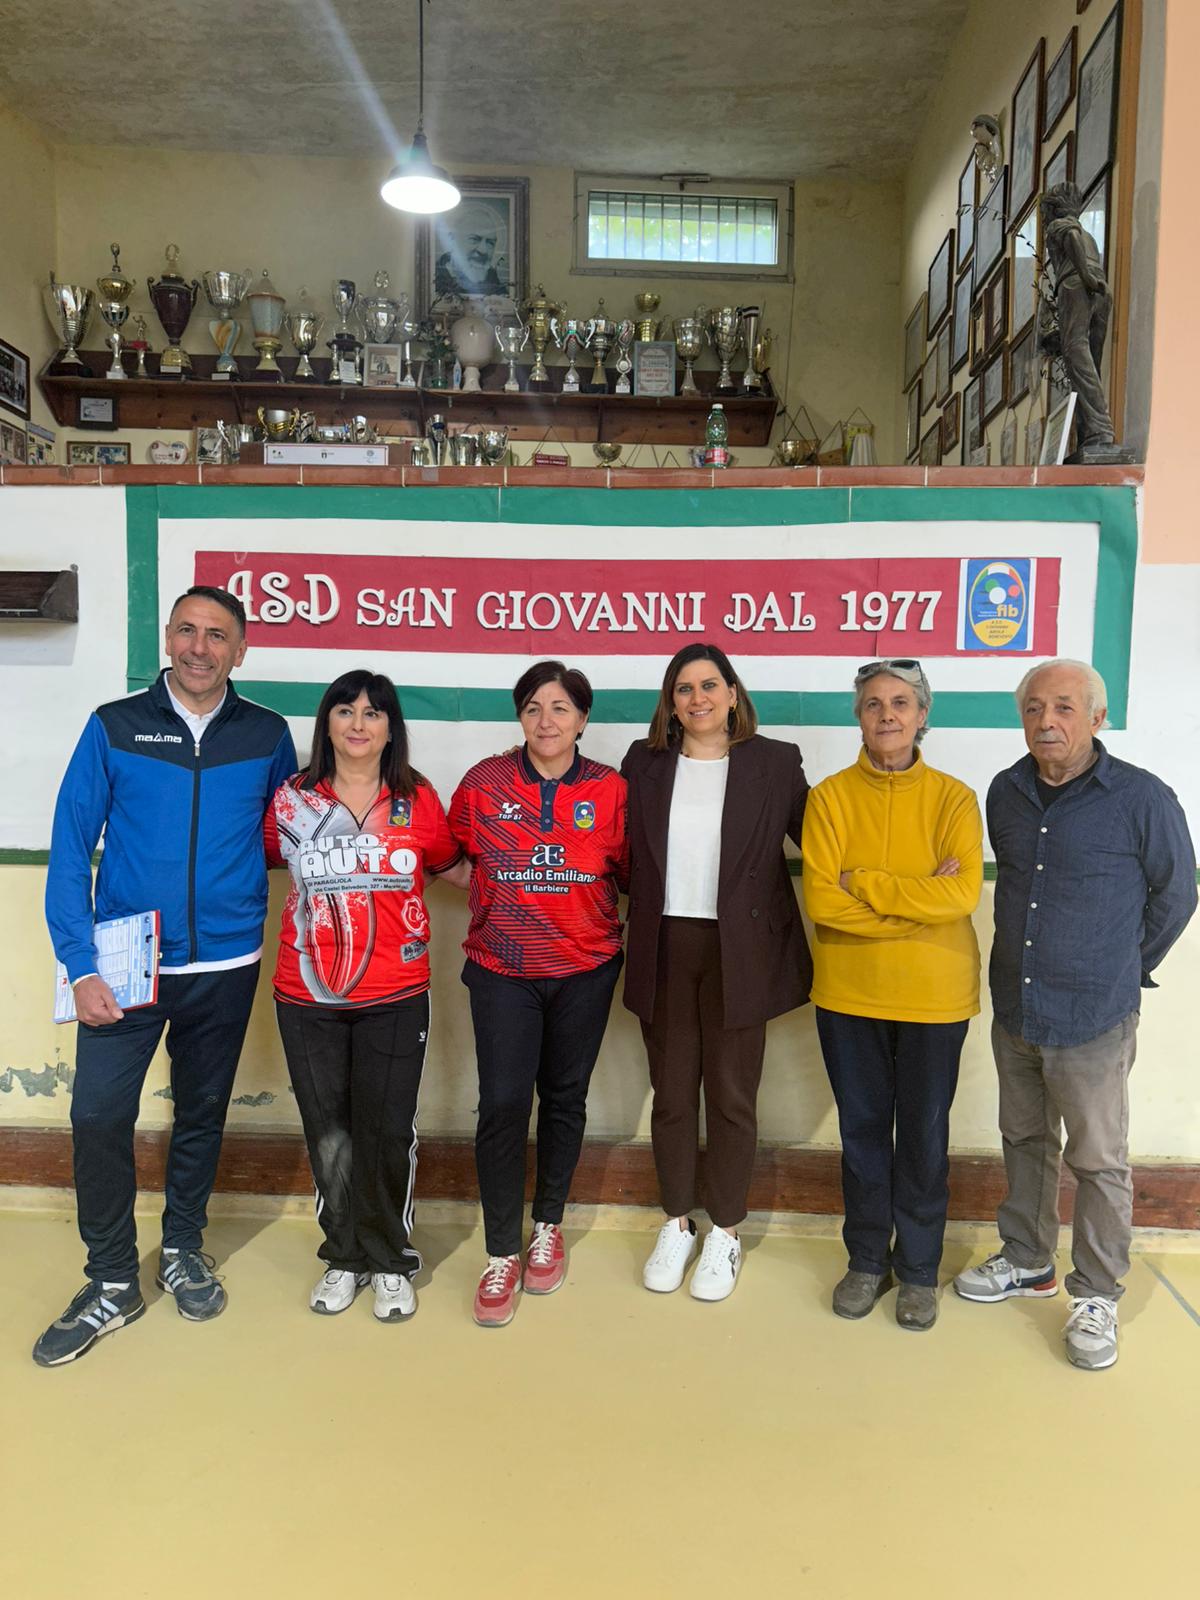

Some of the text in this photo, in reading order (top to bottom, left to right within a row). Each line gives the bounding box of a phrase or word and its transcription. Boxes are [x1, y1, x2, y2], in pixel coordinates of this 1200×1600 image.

[217, 570, 943, 633] ASD SAN GIOVANNI DAL 1977
[996, 603, 1019, 618] fib
[300, 833, 380, 854] AUTO
[300, 847, 418, 879] AUTO
[496, 868, 597, 883] Arcadio Emiliano
[532, 884, 569, 893] Barbiere
